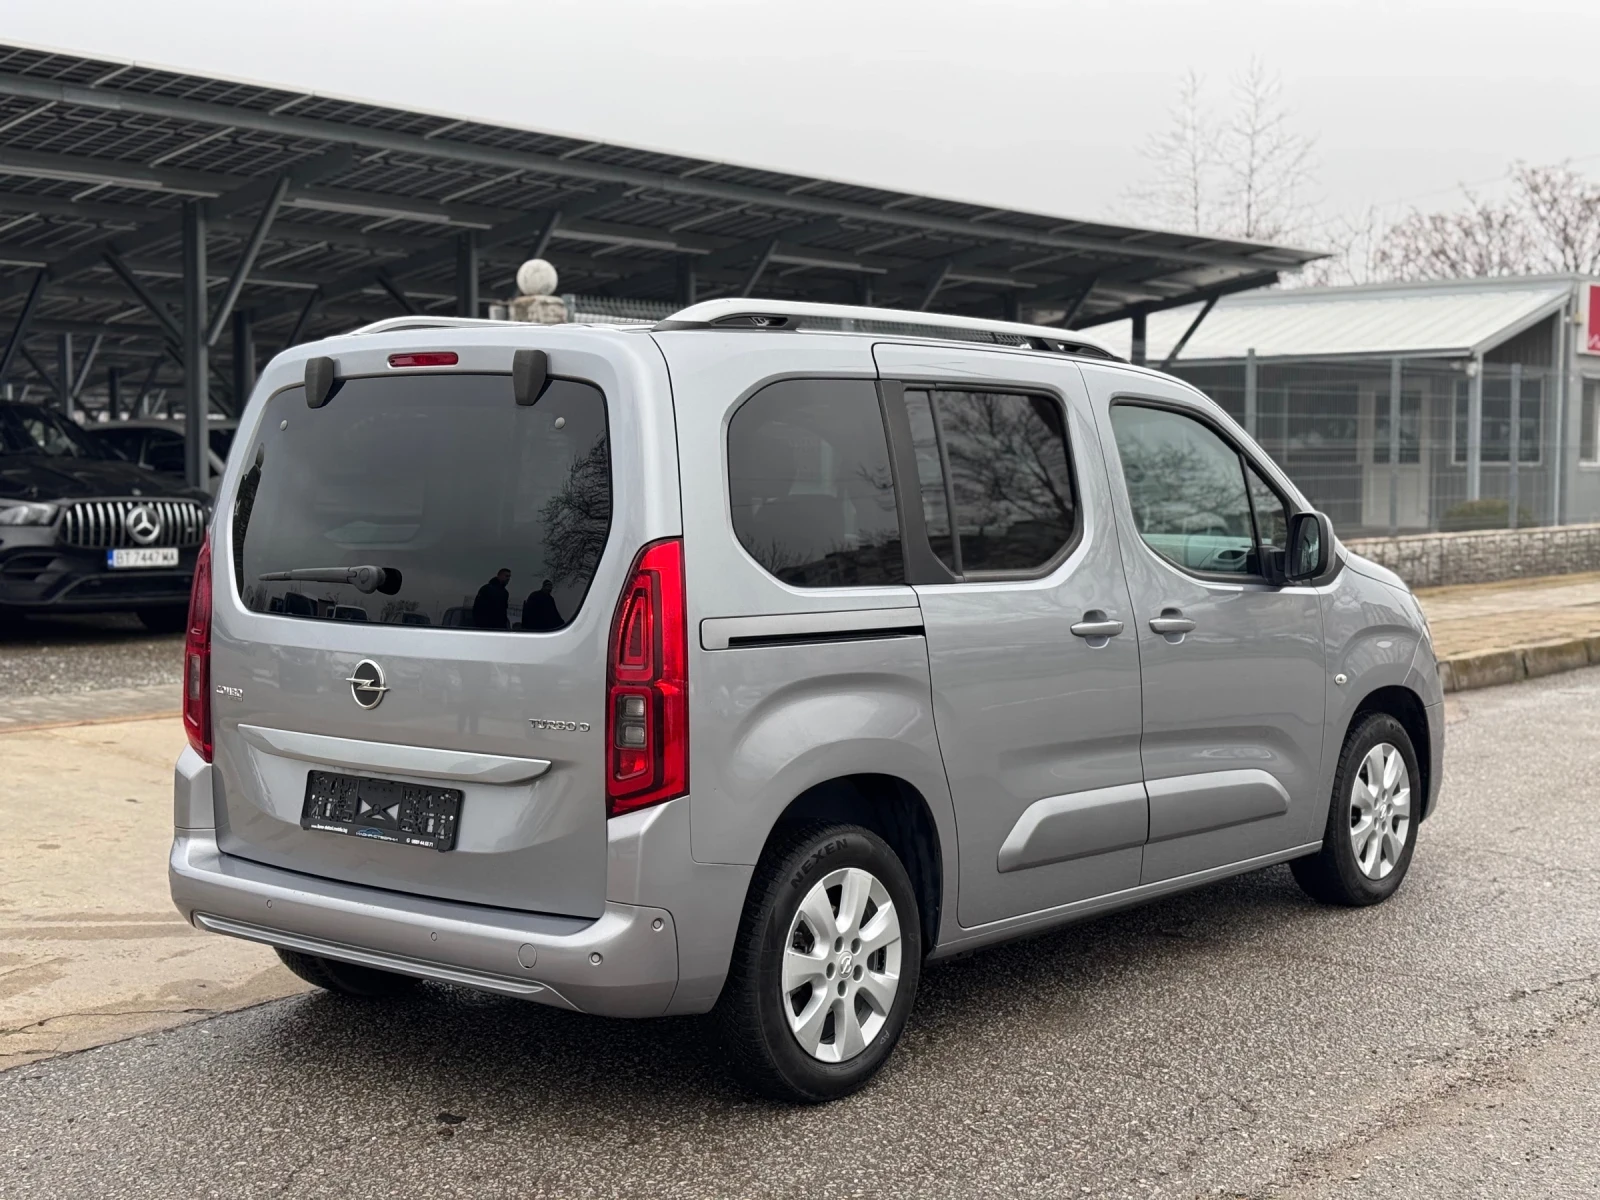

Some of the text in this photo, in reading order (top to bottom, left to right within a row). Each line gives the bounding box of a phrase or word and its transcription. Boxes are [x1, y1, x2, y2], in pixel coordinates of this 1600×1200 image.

[528, 718, 591, 733] TURBO D
[790, 838, 848, 890] NEXEN
